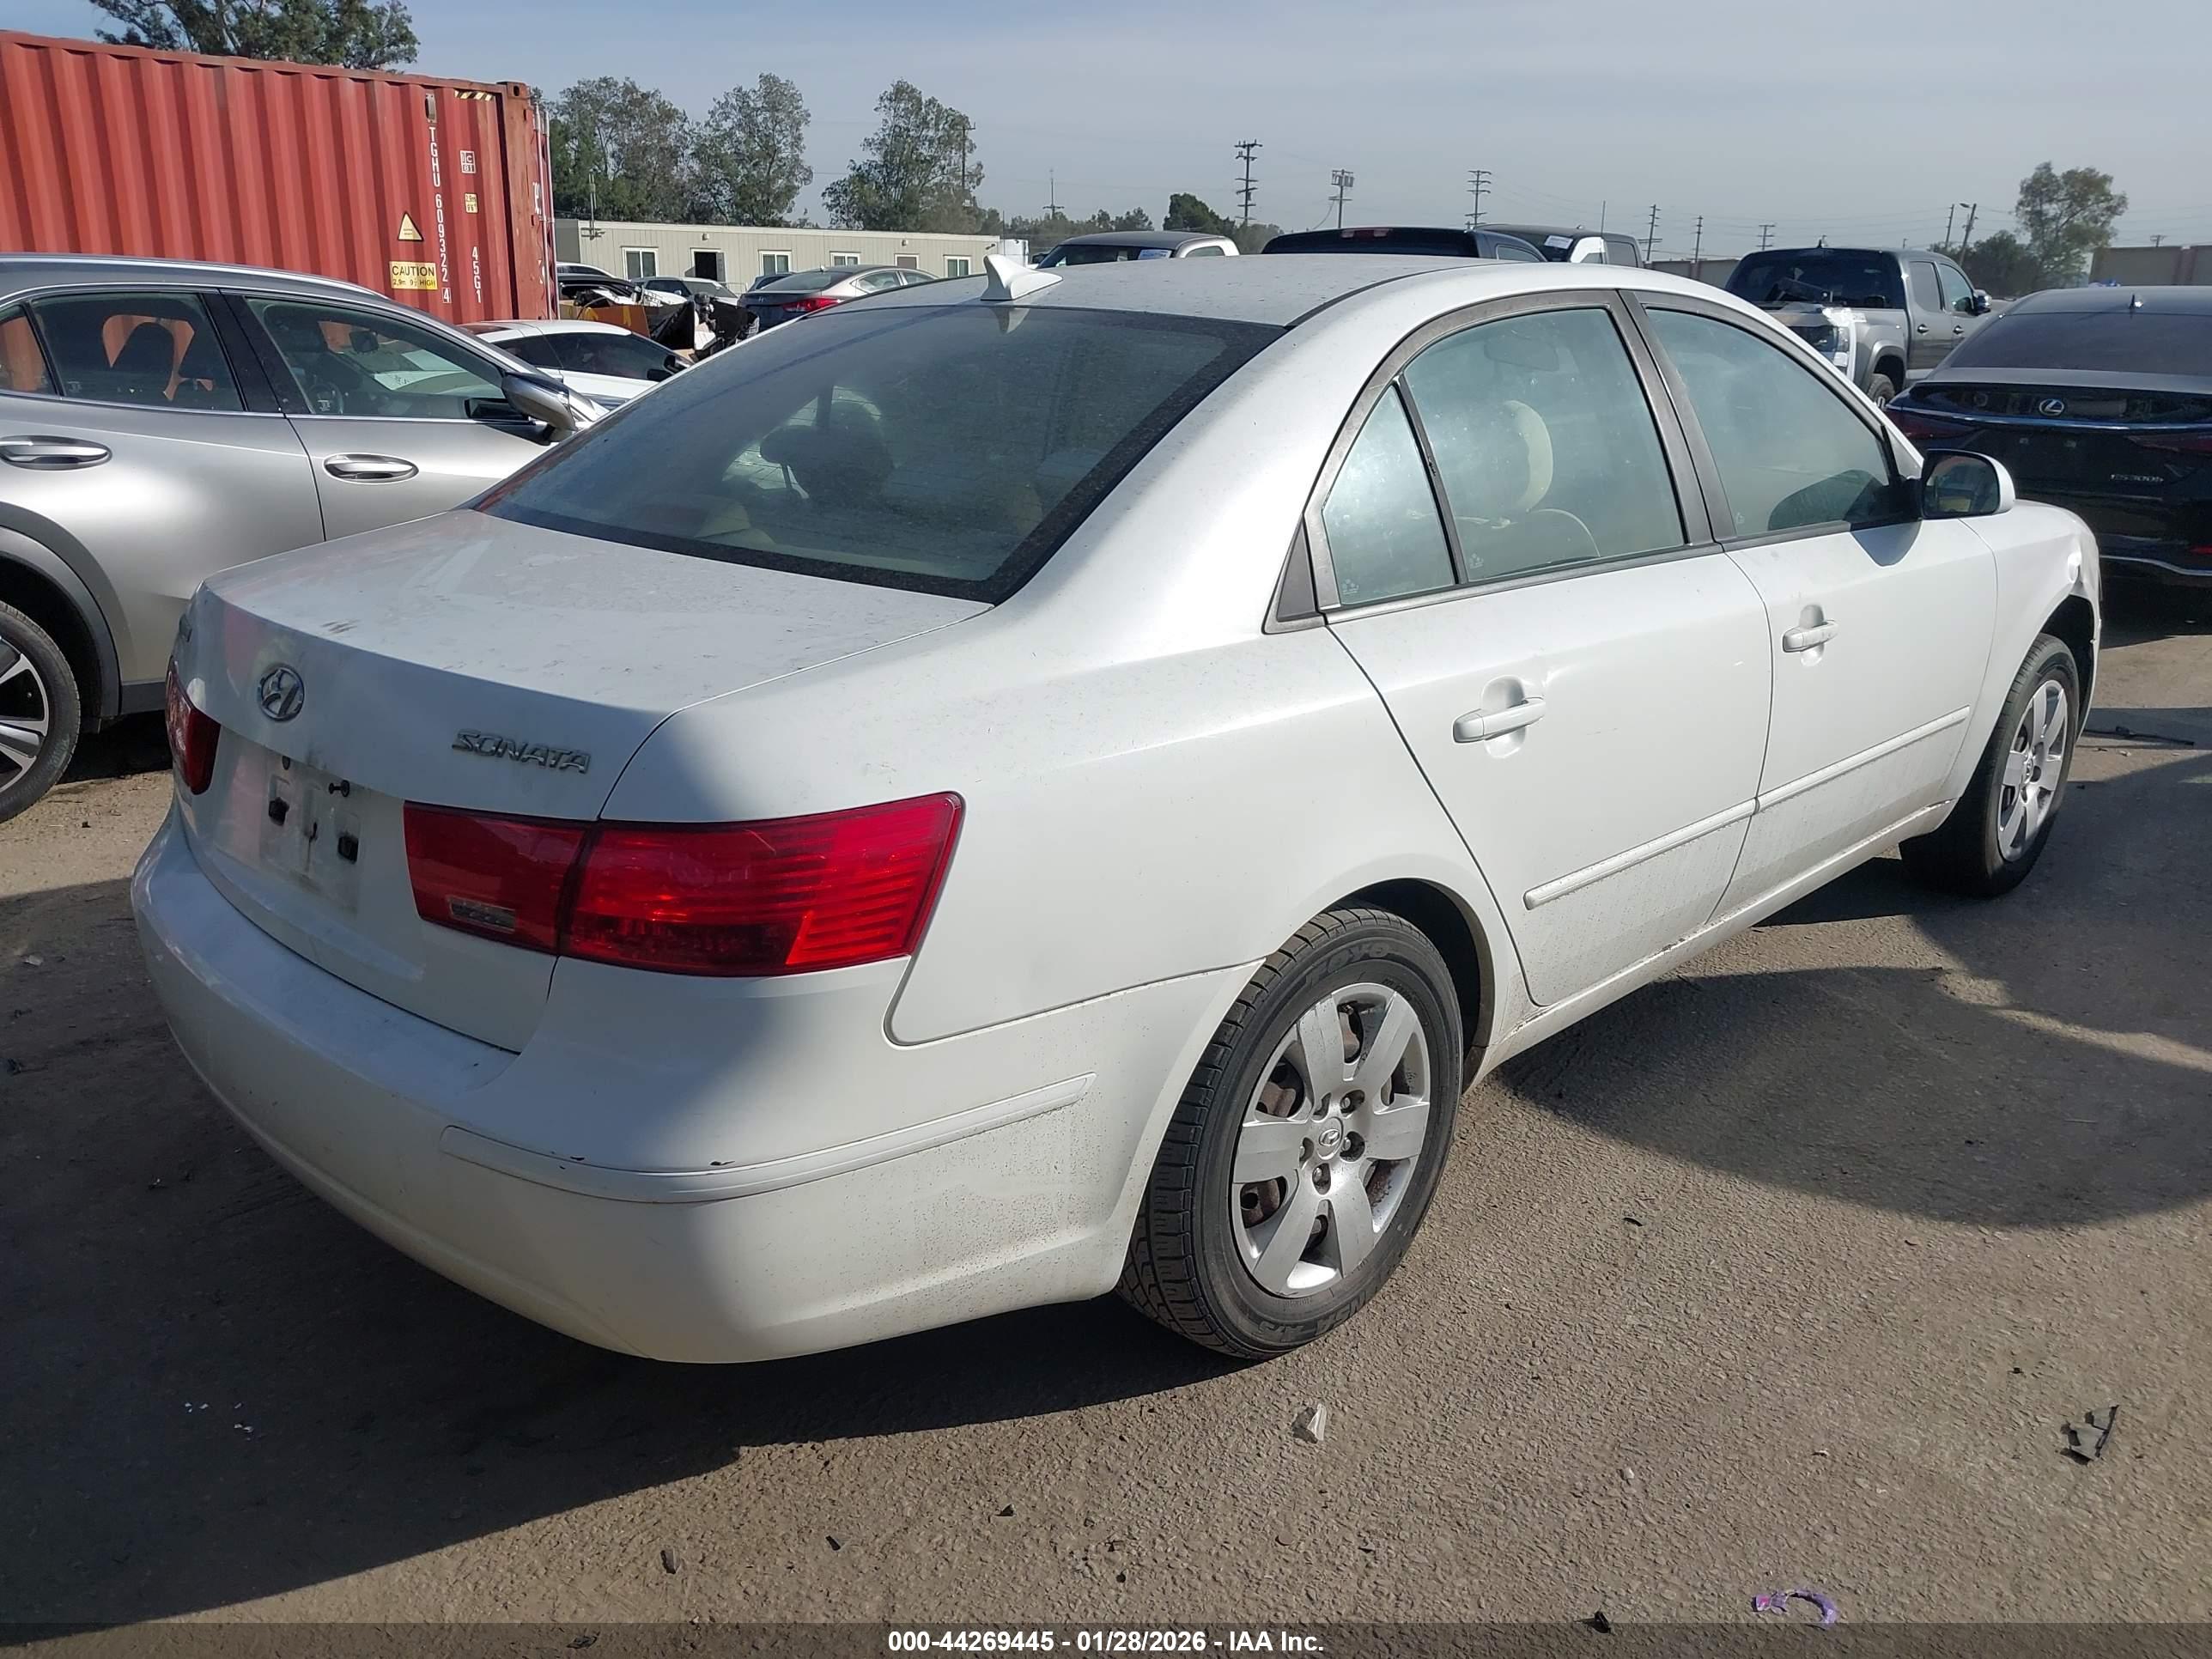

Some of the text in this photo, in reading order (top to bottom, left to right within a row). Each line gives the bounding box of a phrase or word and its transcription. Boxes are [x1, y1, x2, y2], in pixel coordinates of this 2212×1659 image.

[428, 126, 441, 187] TGHU
[435, 193, 448, 283] 609322
[392, 265, 434, 276] CAUTION
[472, 246, 481, 303] 45G1
[452, 730, 591, 774] SONATA
